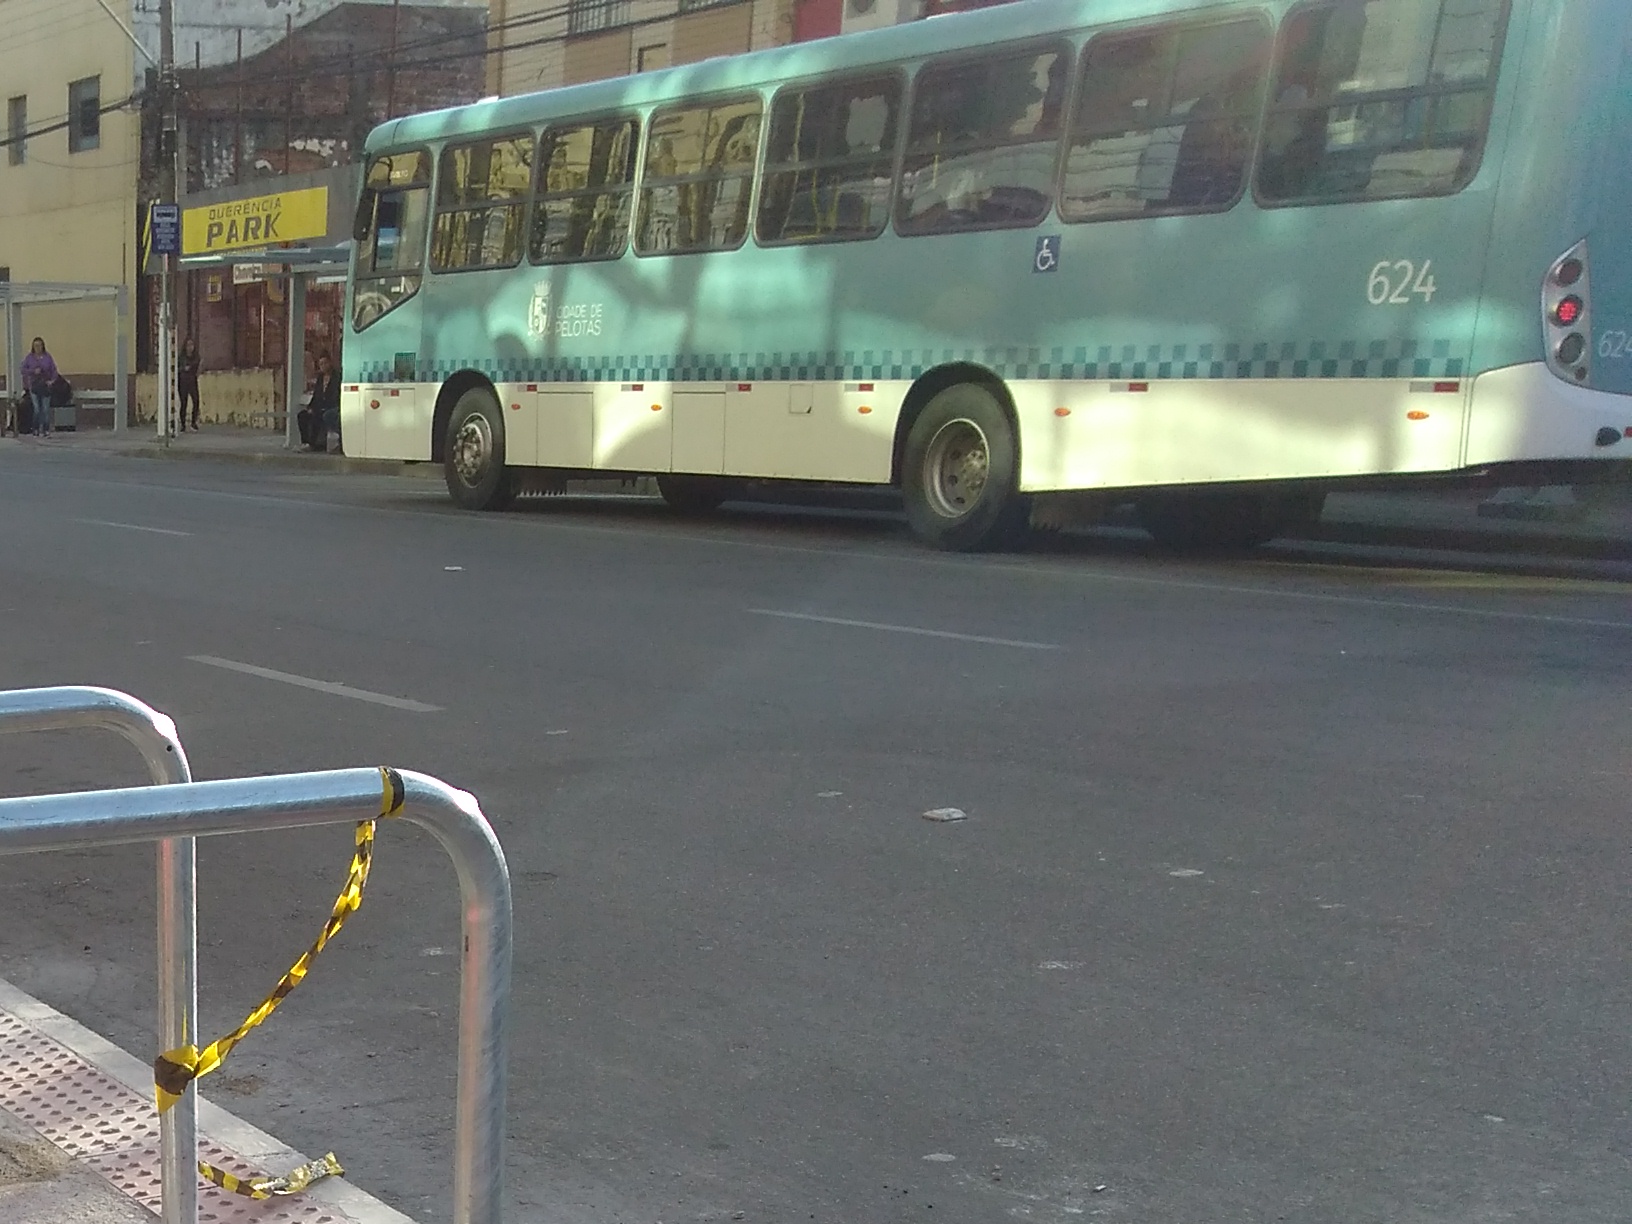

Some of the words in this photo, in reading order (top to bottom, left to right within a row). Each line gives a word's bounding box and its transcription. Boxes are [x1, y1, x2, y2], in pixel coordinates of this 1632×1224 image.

[209, 197, 282, 221] QUERÊNCIA
[206, 212, 282, 248] PARK
[1367, 259, 1437, 305] 624
[556, 304, 587, 319] CIDADE
[590, 303, 603, 318] DE
[555, 319, 602, 337] PELOTAS
